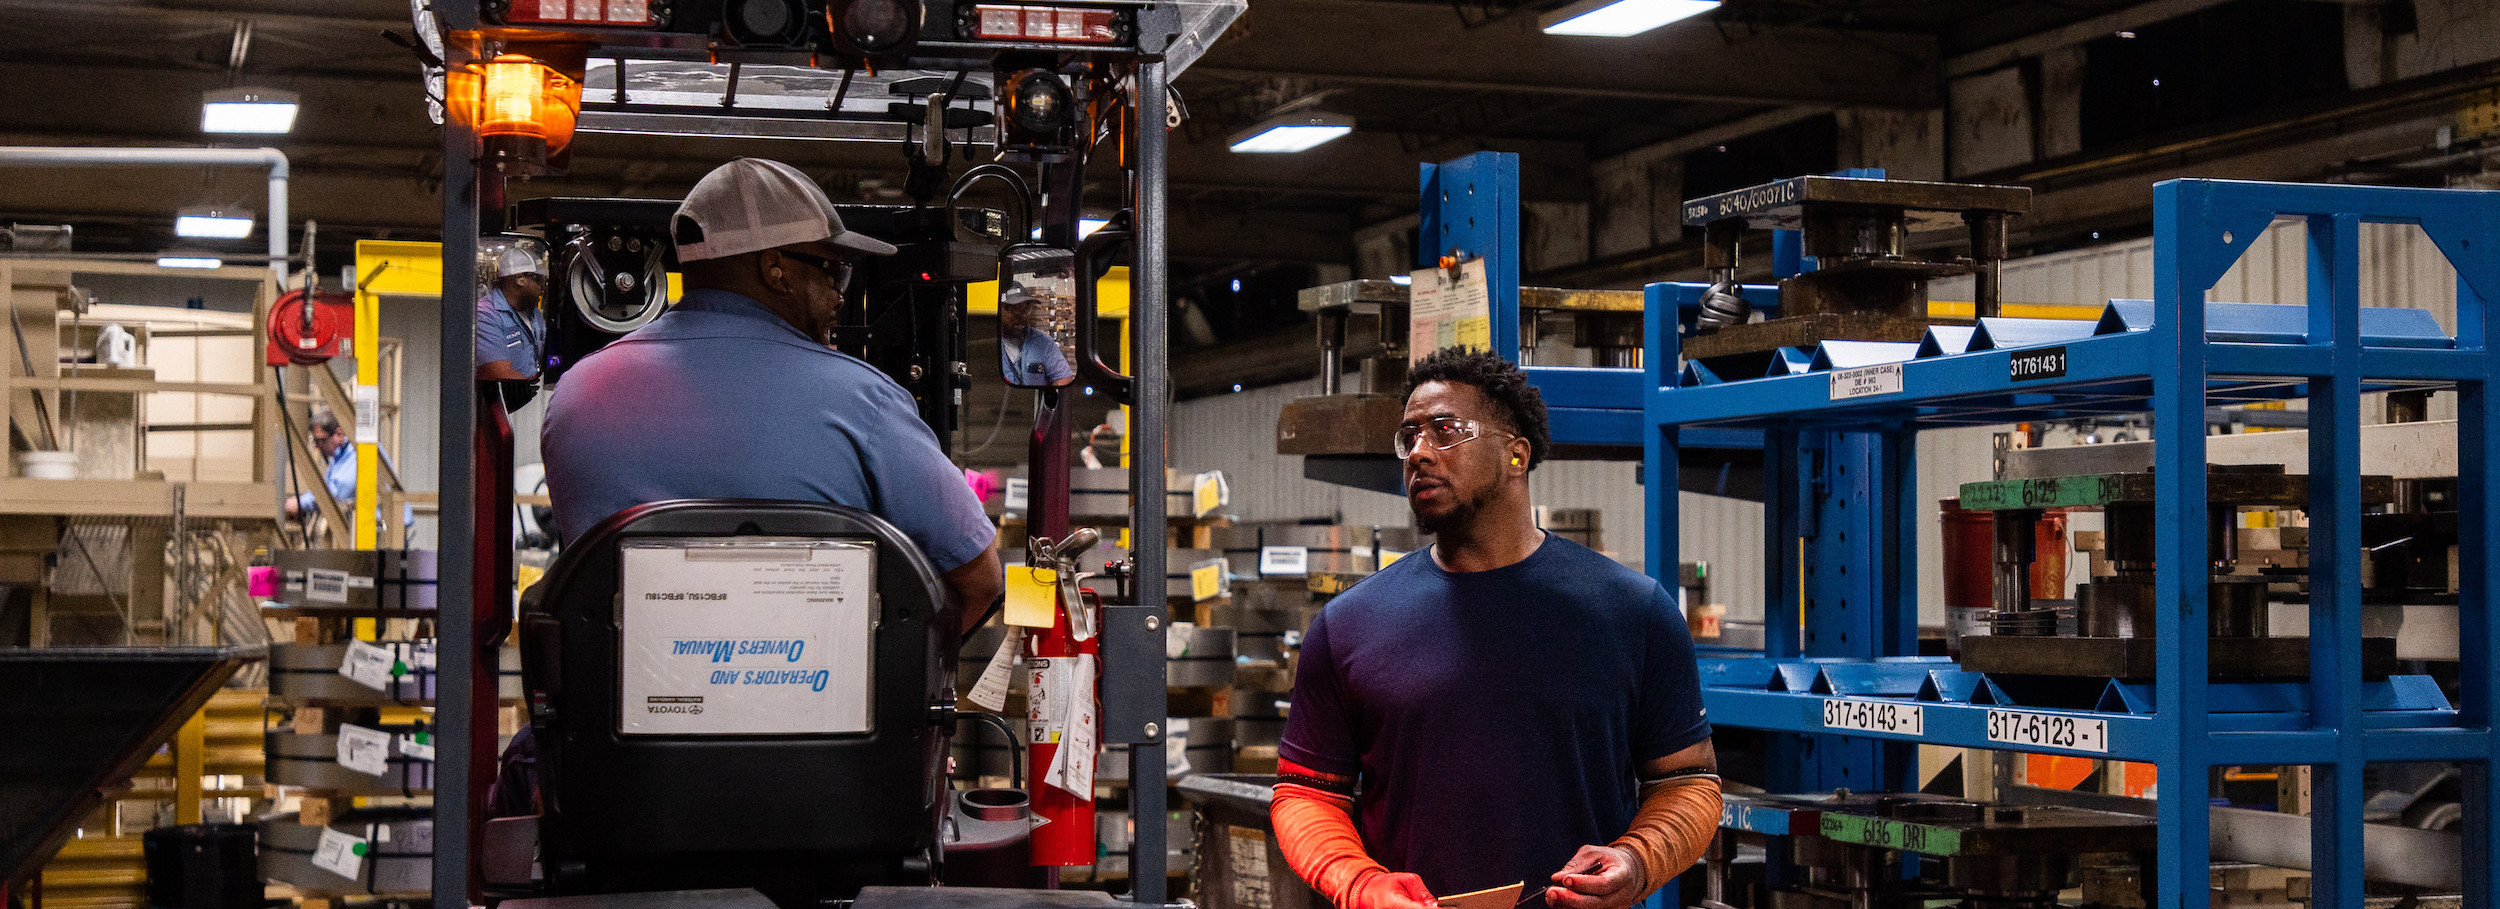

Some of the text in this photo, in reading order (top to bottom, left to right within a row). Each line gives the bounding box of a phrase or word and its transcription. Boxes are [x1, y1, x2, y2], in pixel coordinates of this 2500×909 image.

[1880, 366, 1894, 374] CASE)
[2011, 354, 2065, 376] 3176143 1
[1849, 386, 1872, 396] LOCATION
[1854, 378, 1862, 386] DIE
[672, 640, 804, 663] OWNER'S MANUAL
[710, 670, 829, 692] OPERATOR'S AND
[1825, 700, 1897, 731] 317-6143
[1914, 707, 1921, 733] 1
[1989, 711, 2075, 746] 317-6123
[2096, 721, 2104, 749] 1
[1864, 820, 1891, 844] 6136
